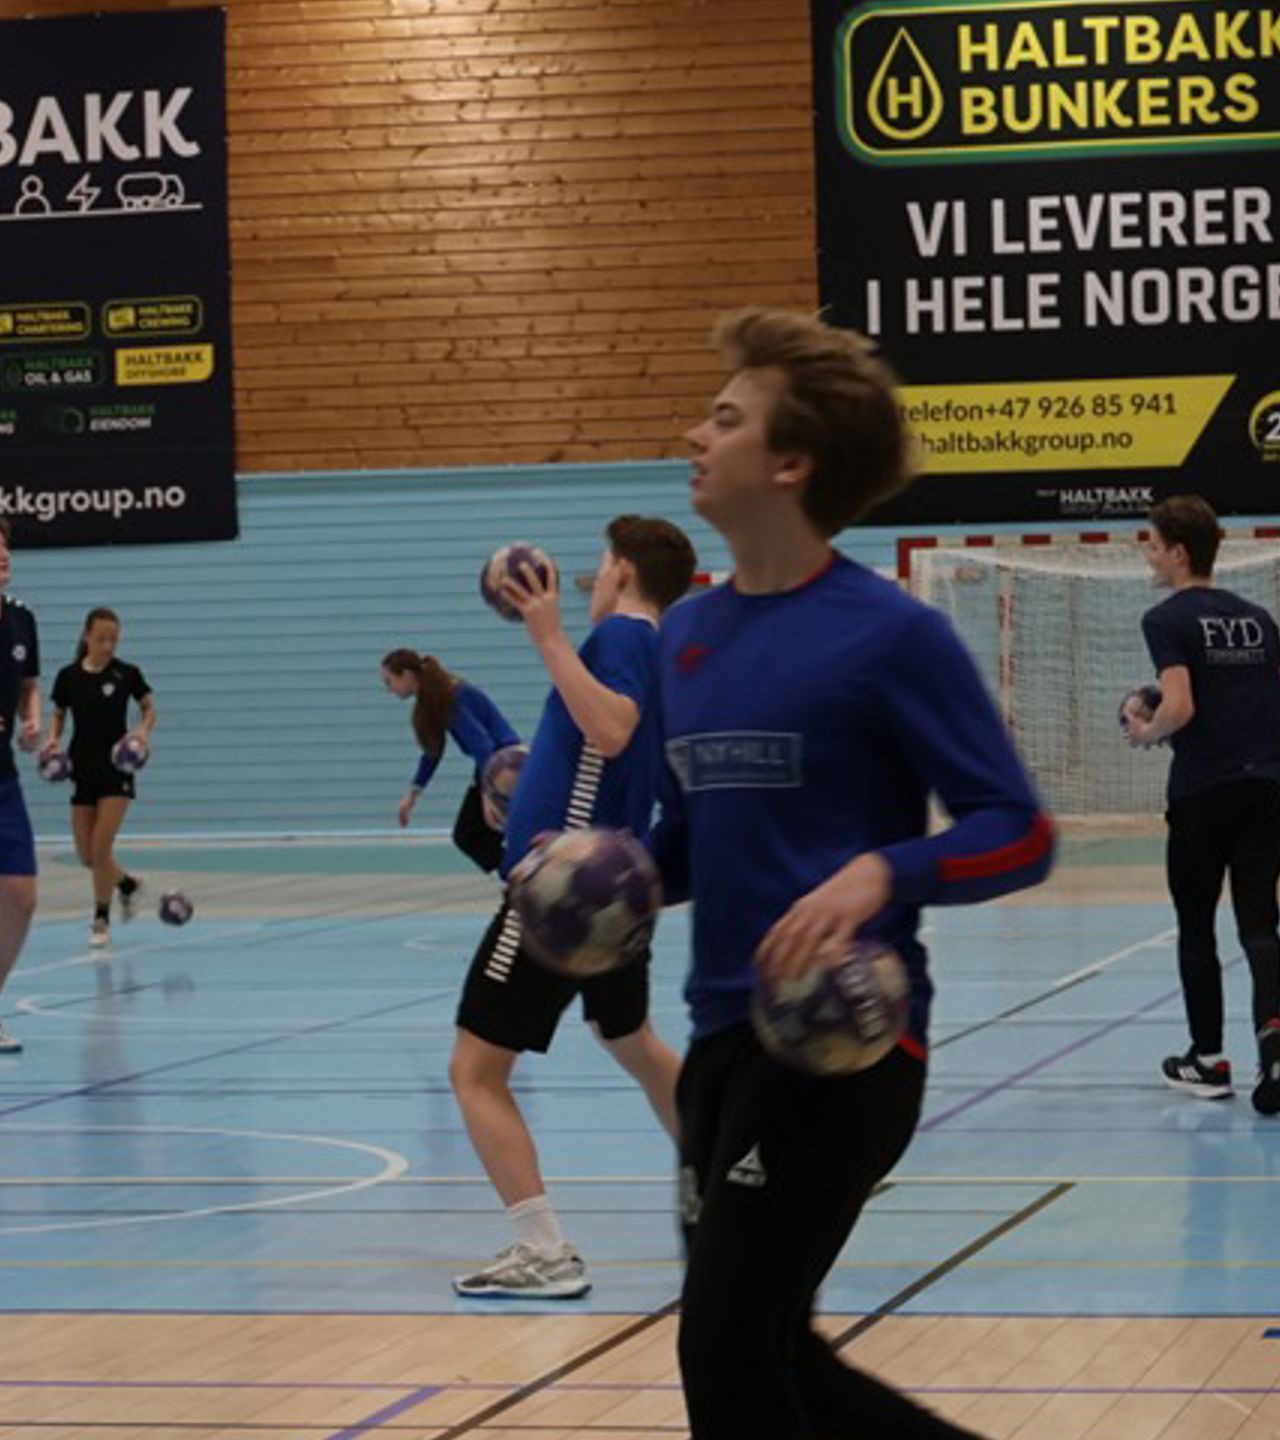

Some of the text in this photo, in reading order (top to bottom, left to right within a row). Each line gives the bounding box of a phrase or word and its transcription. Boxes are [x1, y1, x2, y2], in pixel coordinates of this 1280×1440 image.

[887, 76, 921, 119] H
[961, 73, 1260, 135] BUNKERS
[906, 187, 1273, 257] VI LEVERER
[867, 279, 880, 335] I
[906, 273, 1061, 334] HELE
[125, 351, 203, 366] HALTBAKK
[24, 372, 48, 386] OIL
[64, 369, 92, 384] GAS
[1037, 395, 1085, 418] 926
[1092, 394, 1124, 416] 85
[1131, 392, 1177, 415] 941
[915, 428, 1134, 457] haltbakkgroup.no
[1059, 486, 1154, 504] HALTBAKK
[1200, 616, 1264, 648] FYD
